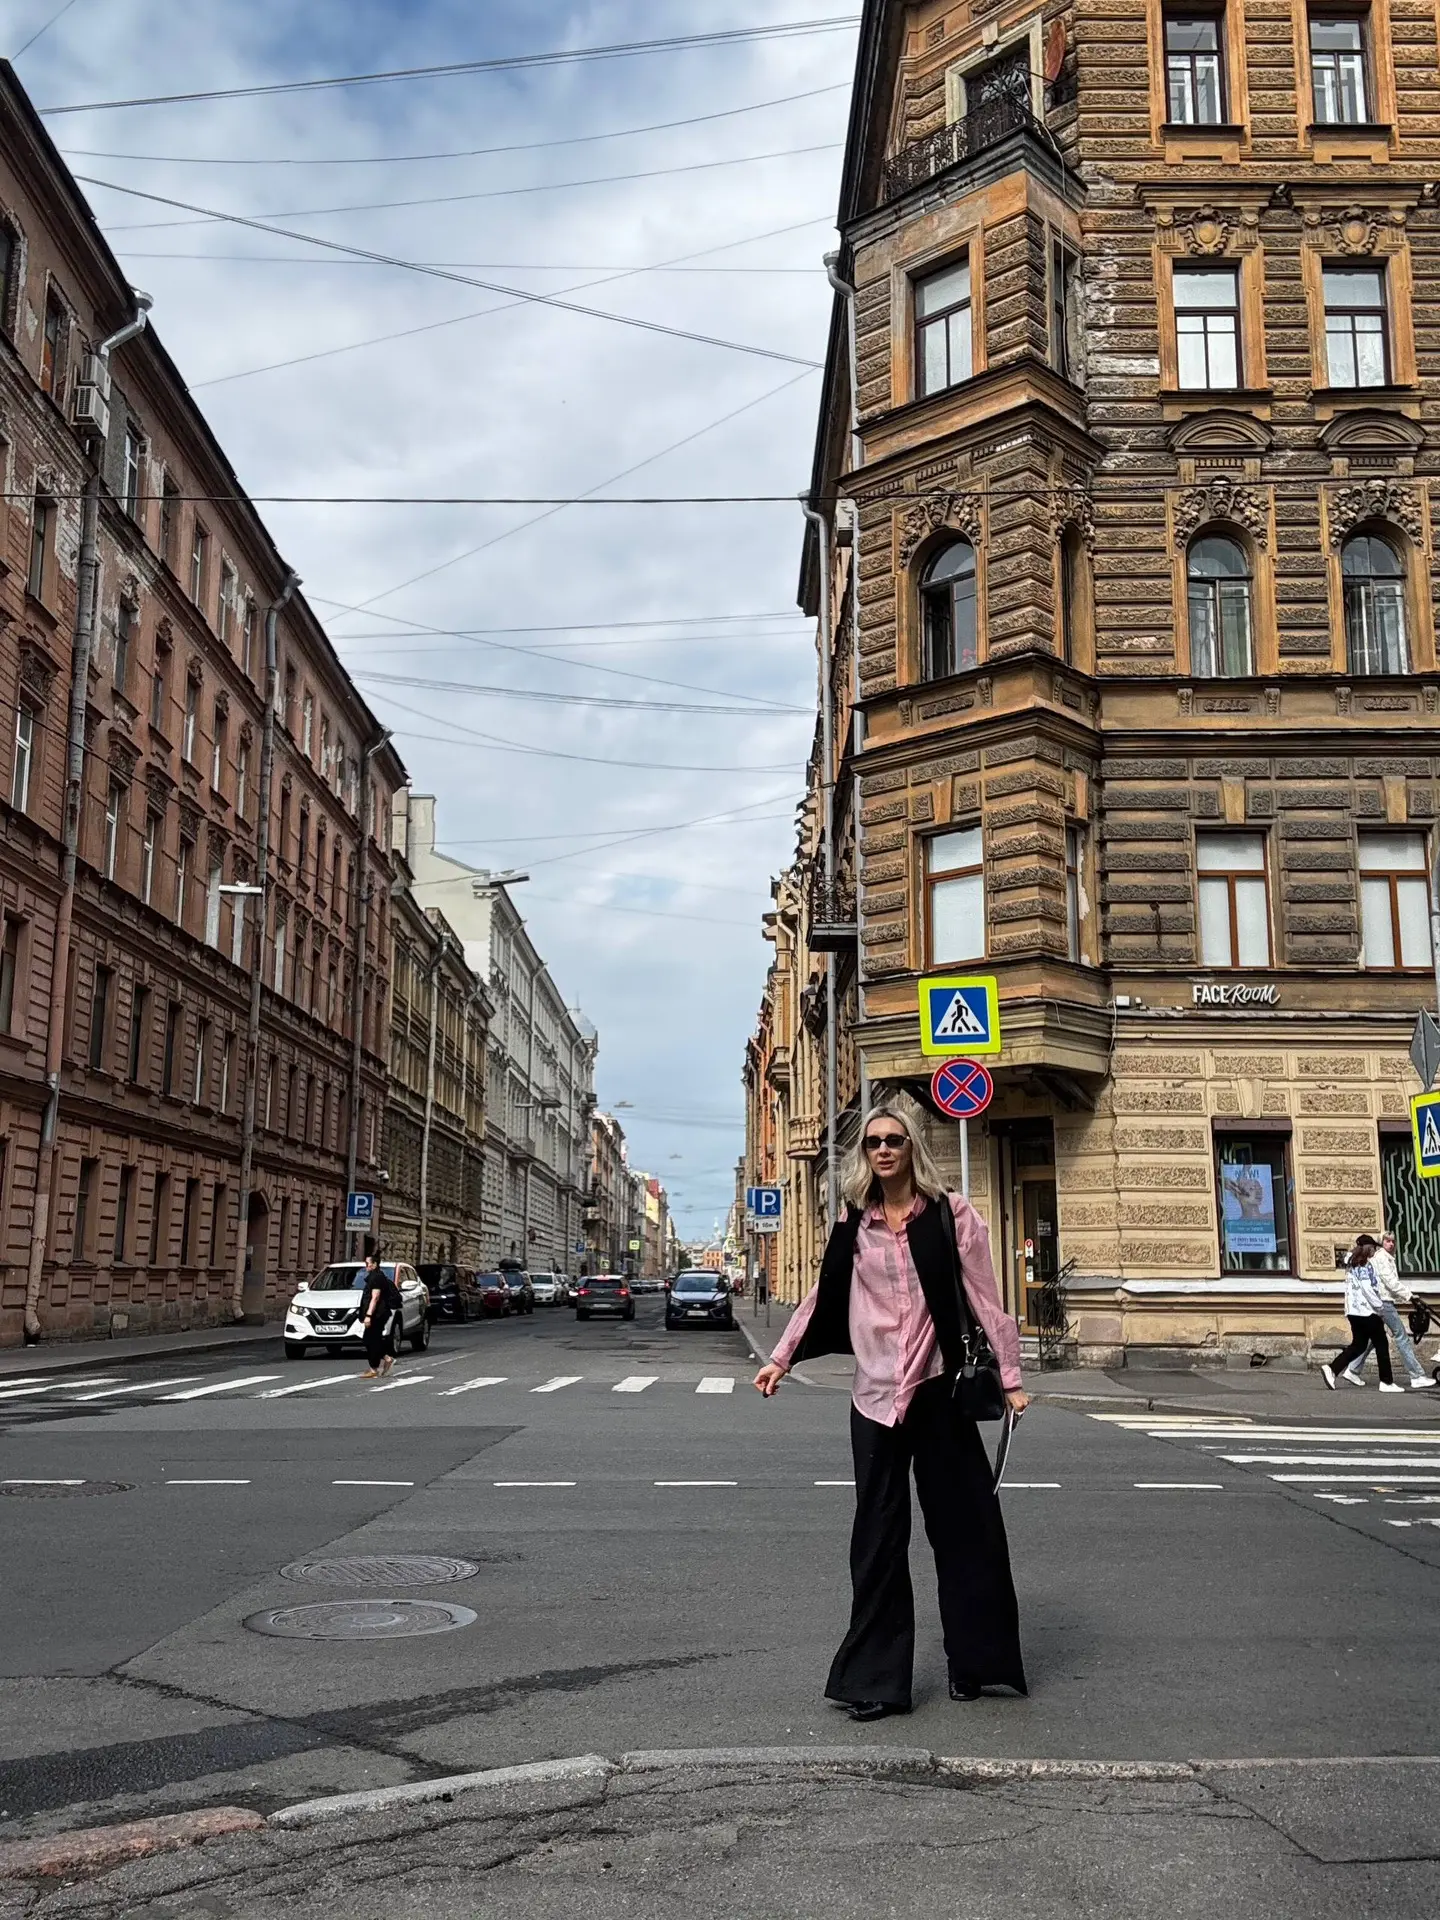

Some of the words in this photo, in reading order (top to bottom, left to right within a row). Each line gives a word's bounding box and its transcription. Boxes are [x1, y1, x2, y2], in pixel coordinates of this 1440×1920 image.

[1193, 985, 1230, 1004] FACE
[354, 1195, 369, 1215] P
[761, 1191, 777, 1213] P
